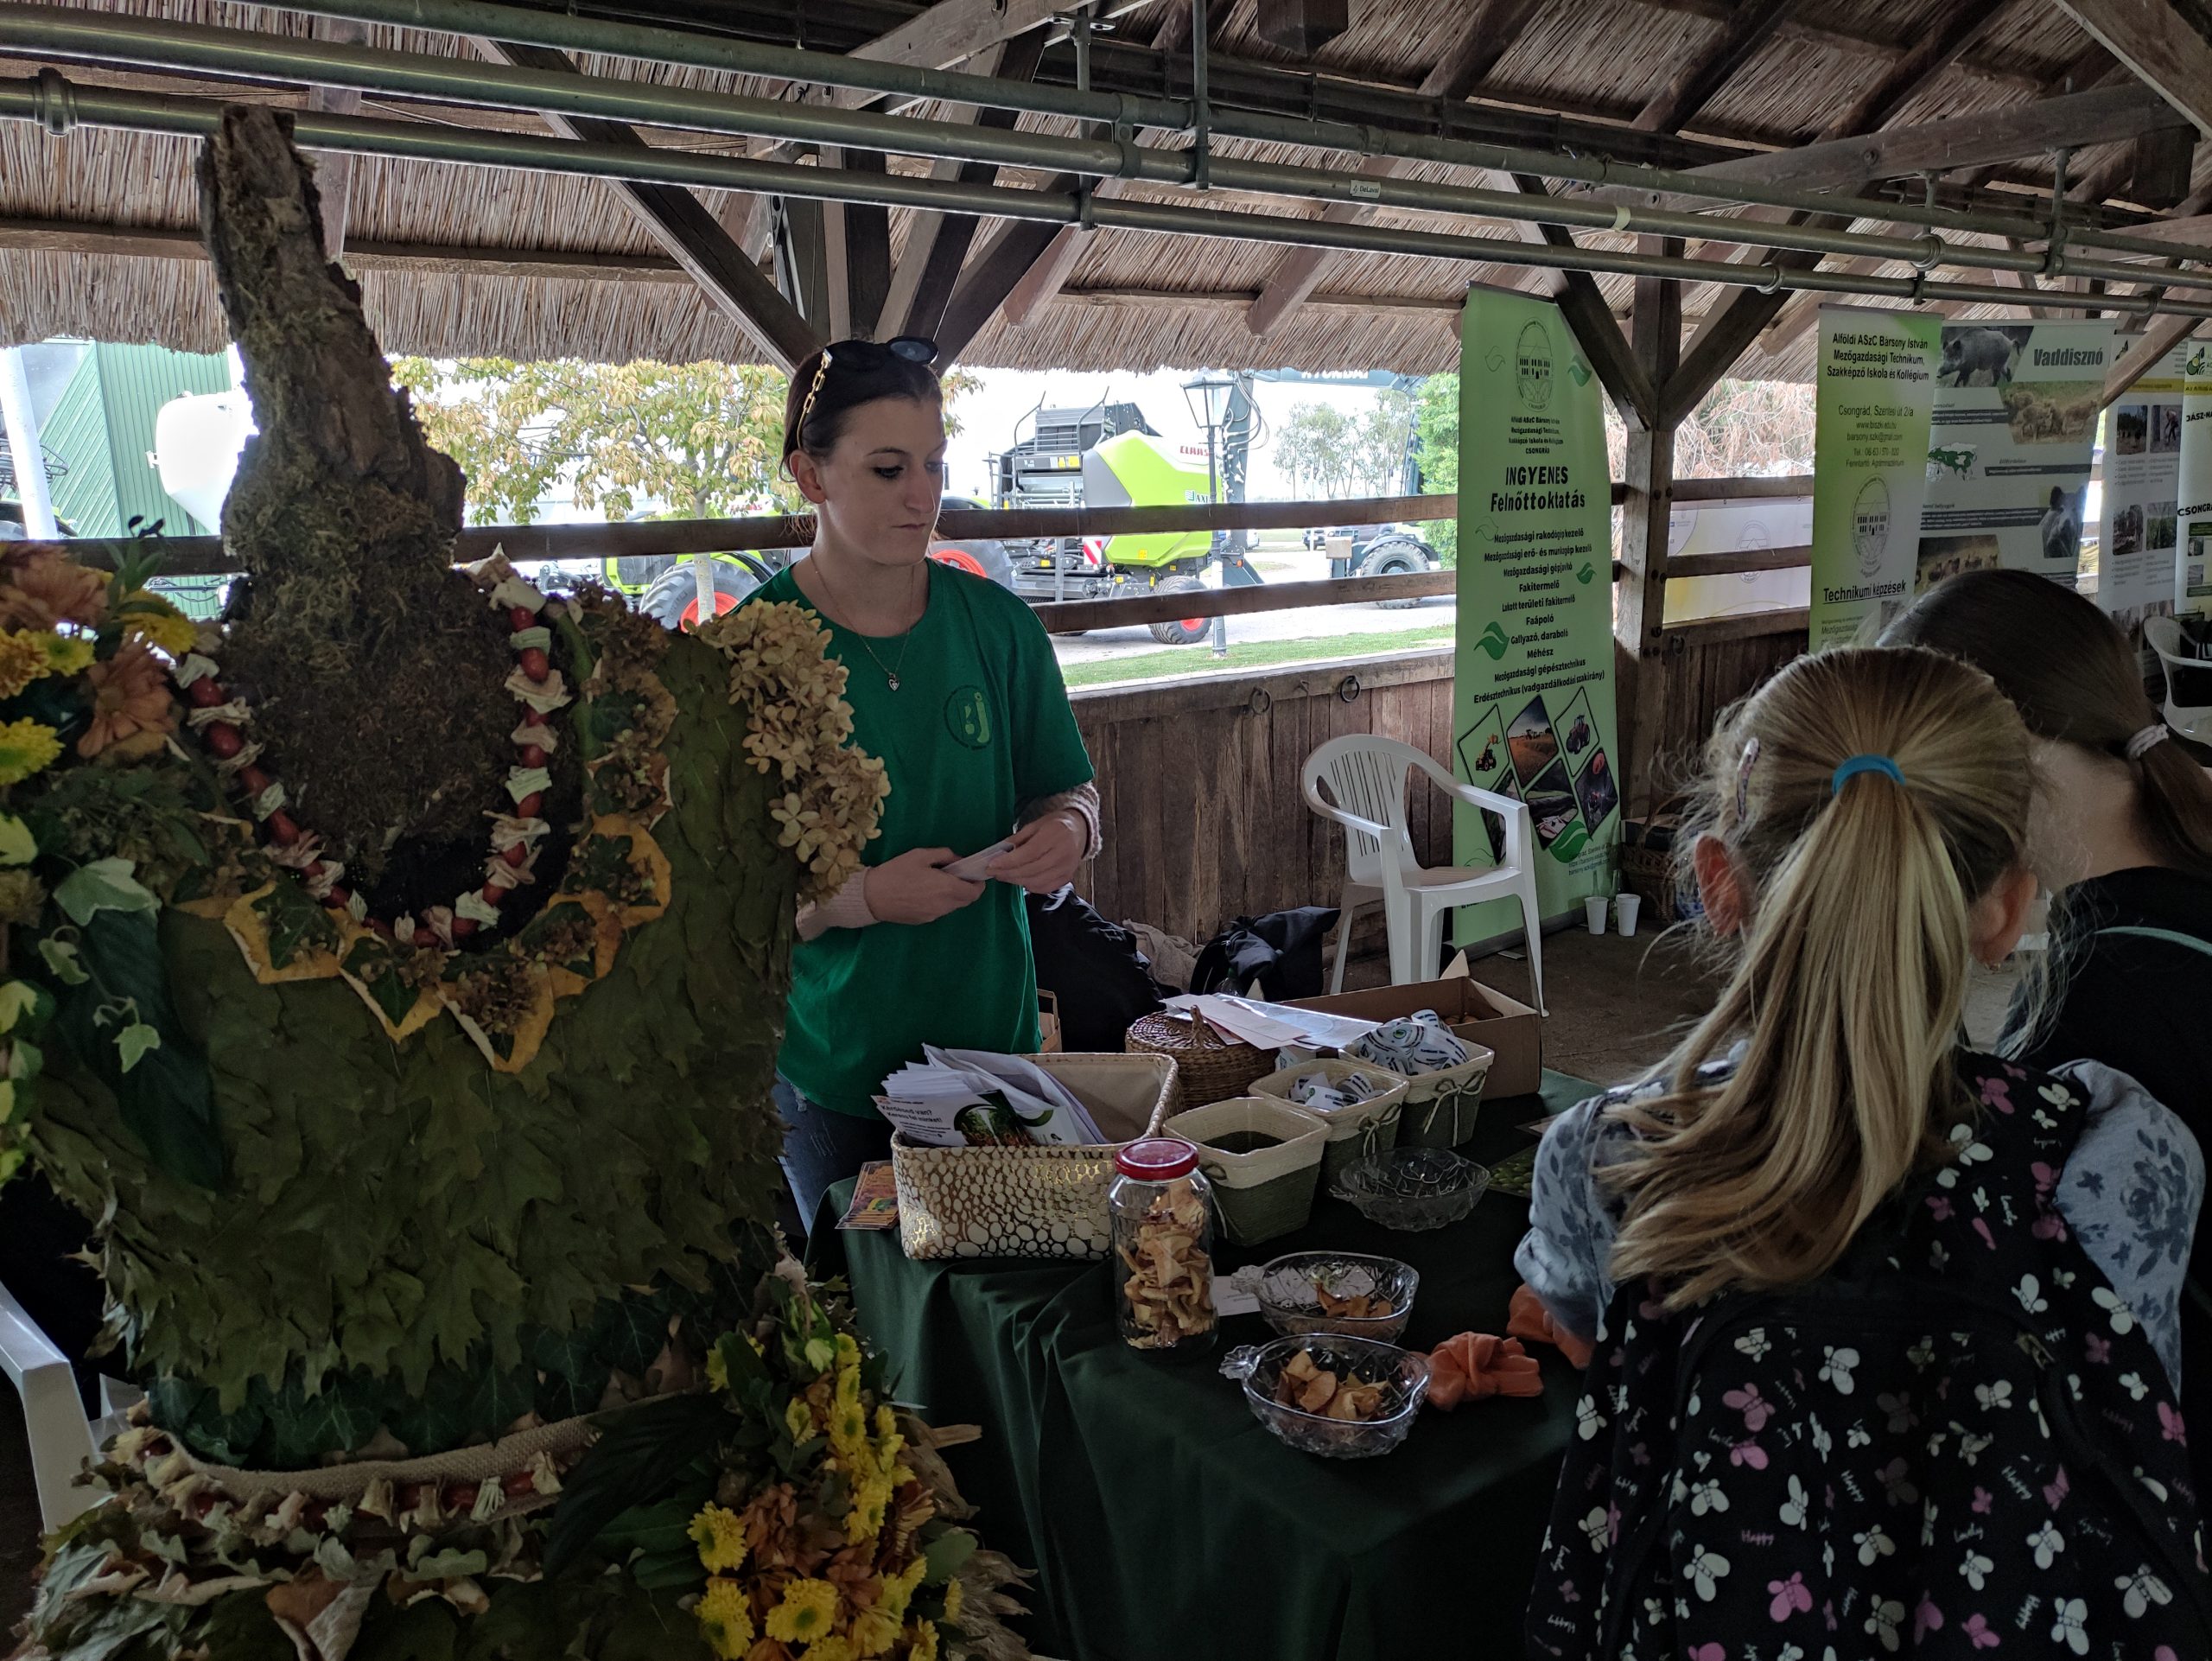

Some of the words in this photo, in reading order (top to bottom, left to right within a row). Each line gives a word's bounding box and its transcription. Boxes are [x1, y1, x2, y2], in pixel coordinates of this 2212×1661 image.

[1833, 333, 1856, 345] Alföldi
[1858, 334, 1878, 346] ASzC
[1879, 335, 1906, 351] Bársony
[1907, 337, 1928, 349] István
[1834, 349, 1888, 365] Mezőgazdasági
[1890, 352, 1925, 365] Technikum,
[2034, 347, 2103, 366] Vaddisznó
[1827, 365, 1866, 379] Szakképző
[1867, 367, 1887, 379] Iskola
[1889, 369, 1896, 378] és
[1897, 369, 1929, 382] Kollégium
[1180, 445, 1210, 456] CLAAS
[1505, 466, 1568, 486] INGYENES
[1491, 490, 1586, 512] Felnőttoktatás
[1494, 531, 1535, 544] Mezőgazdasági
[1484, 549, 1522, 562] Mezőgazdasági
[1539, 548, 1548, 557] és
[1503, 563, 1549, 577] Mezőgazdasági
[1519, 580, 1560, 593] Fakitermelő
[1823, 583, 1872, 602] Technikumi
[1872, 579, 1906, 597] képzések
[1518, 598, 1544, 609] területi
[1545, 595, 1575, 607] fakitermelő
[1526, 614, 1554, 626] Faápoló
[1510, 632, 1540, 645] Gallyazó,
[1541, 628, 1568, 640] daraboló
[1527, 647, 1554, 659] Méhész
[1494, 665, 1537, 682] Mezőgazdasági
[1538, 659, 1586, 676] gépésztechnikus
[1474, 685, 1521, 703] Erdésztechnikus
[1522, 678, 1576, 694] (vadgazdálkodási
[1576, 670, 1605, 683] szakirány)
[1741, 1529, 1775, 1547] Happy
